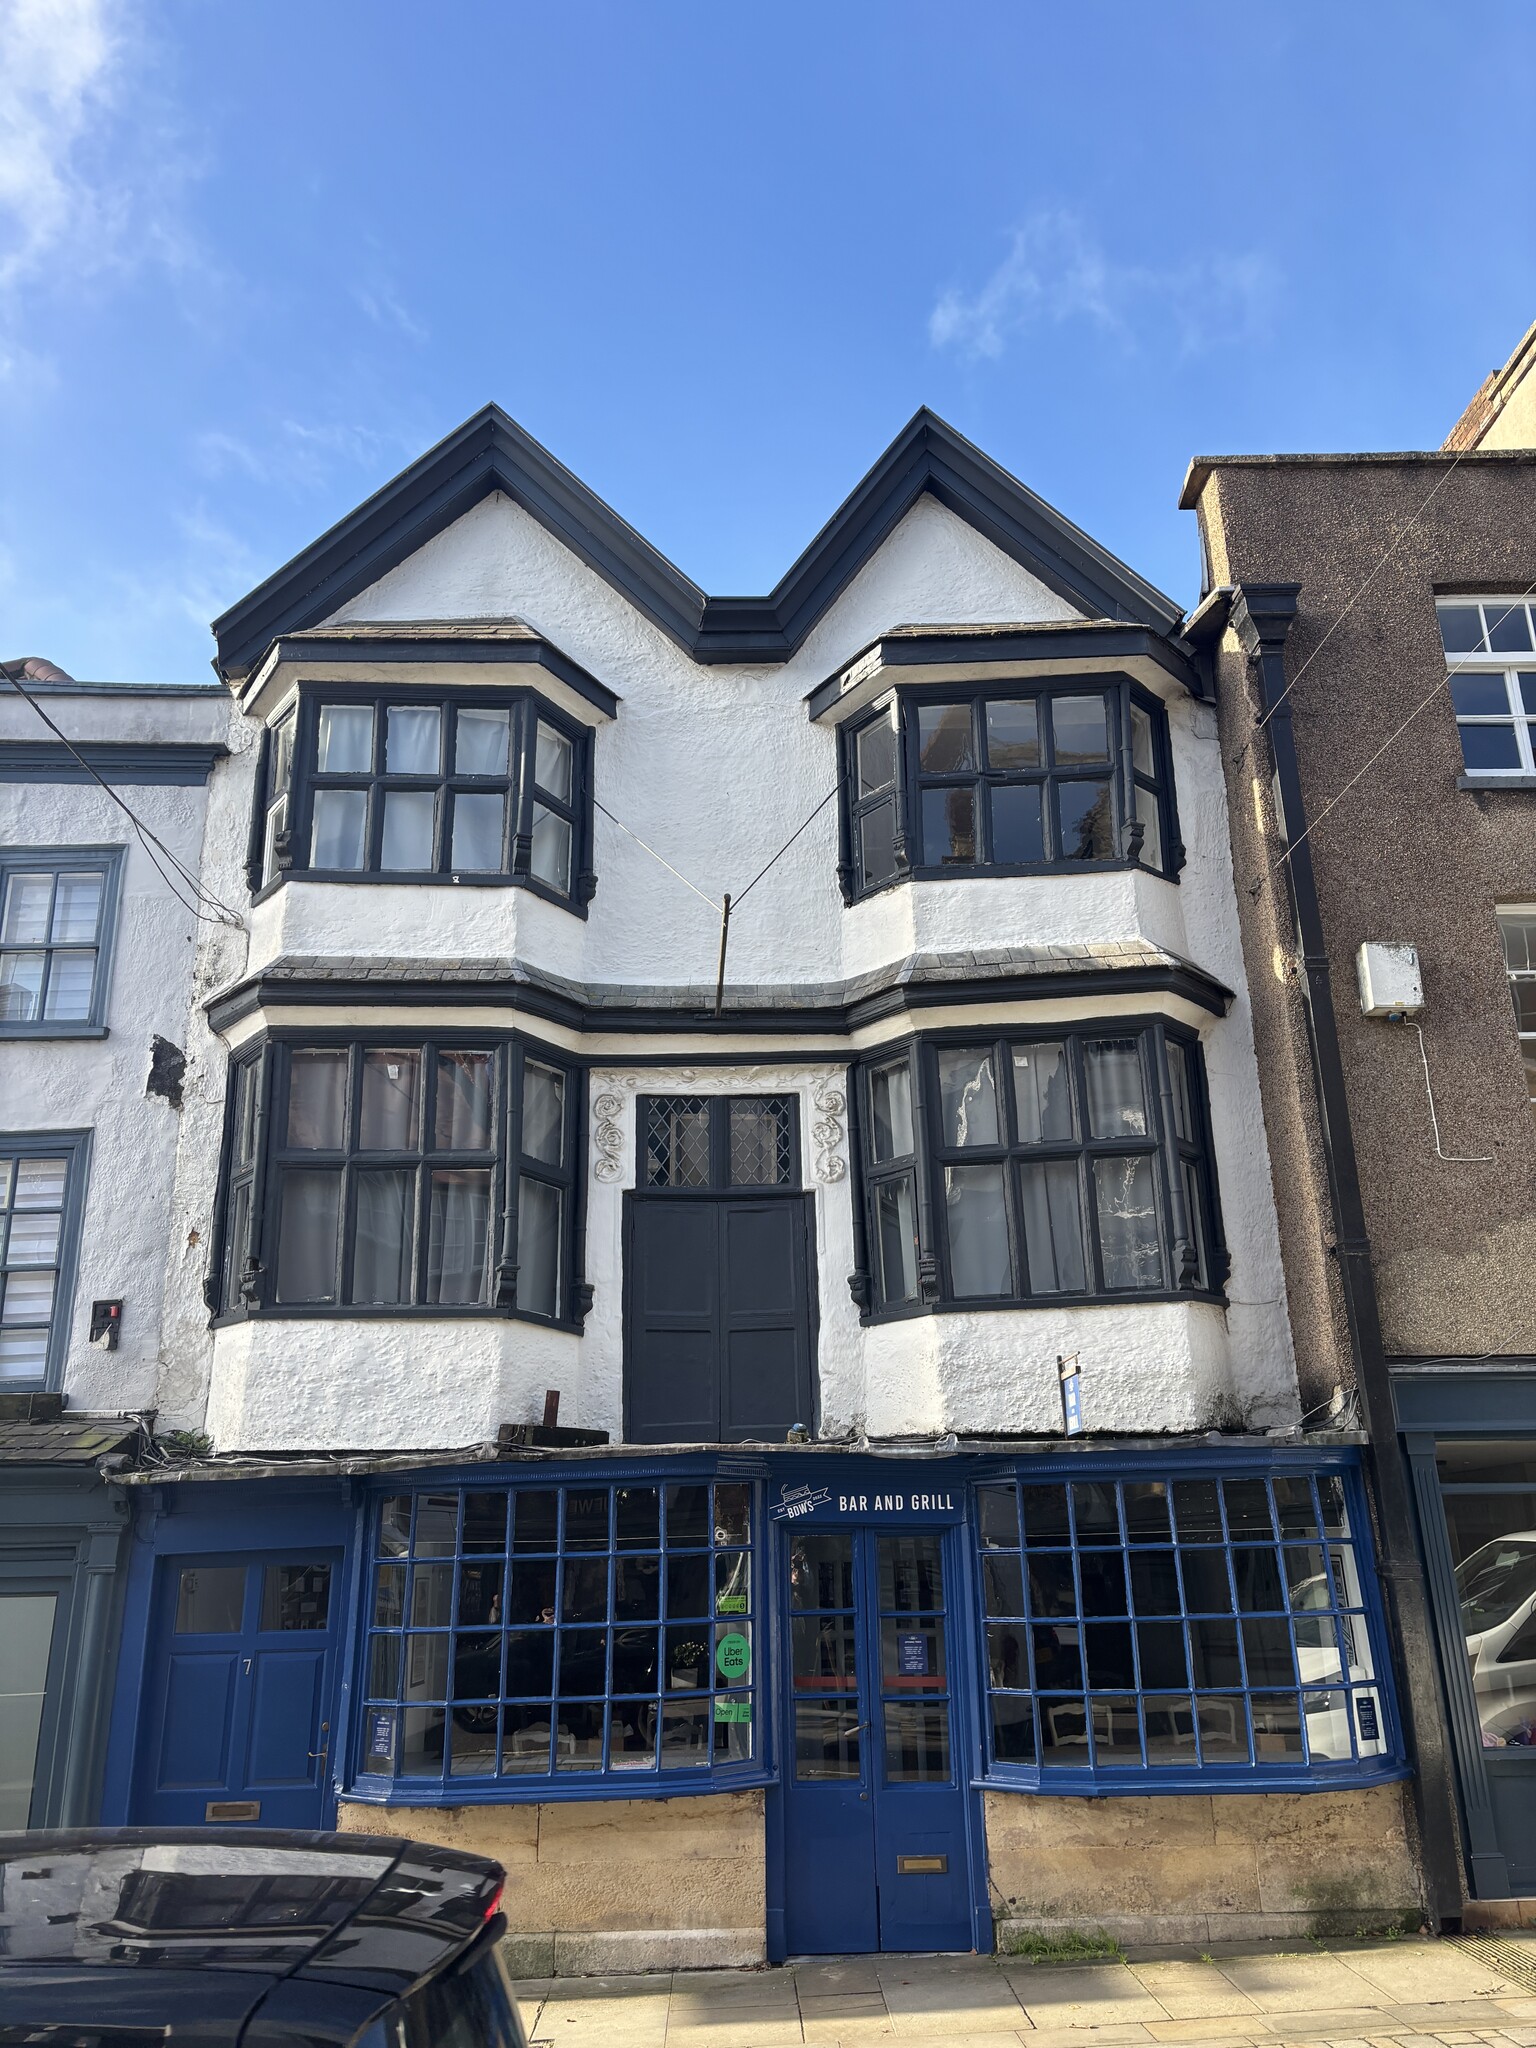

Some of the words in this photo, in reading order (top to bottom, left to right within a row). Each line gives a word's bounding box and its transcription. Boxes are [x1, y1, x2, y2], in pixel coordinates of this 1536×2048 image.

[839, 1495, 868, 1511] BAR
[874, 1495, 904, 1511] AND
[911, 1494, 954, 1510] GRILL
[724, 1647, 743, 1656] Uber
[724, 1657, 743, 1666] Eats
[243, 1659, 251, 1675] 7
[715, 1708, 733, 1717] Open
